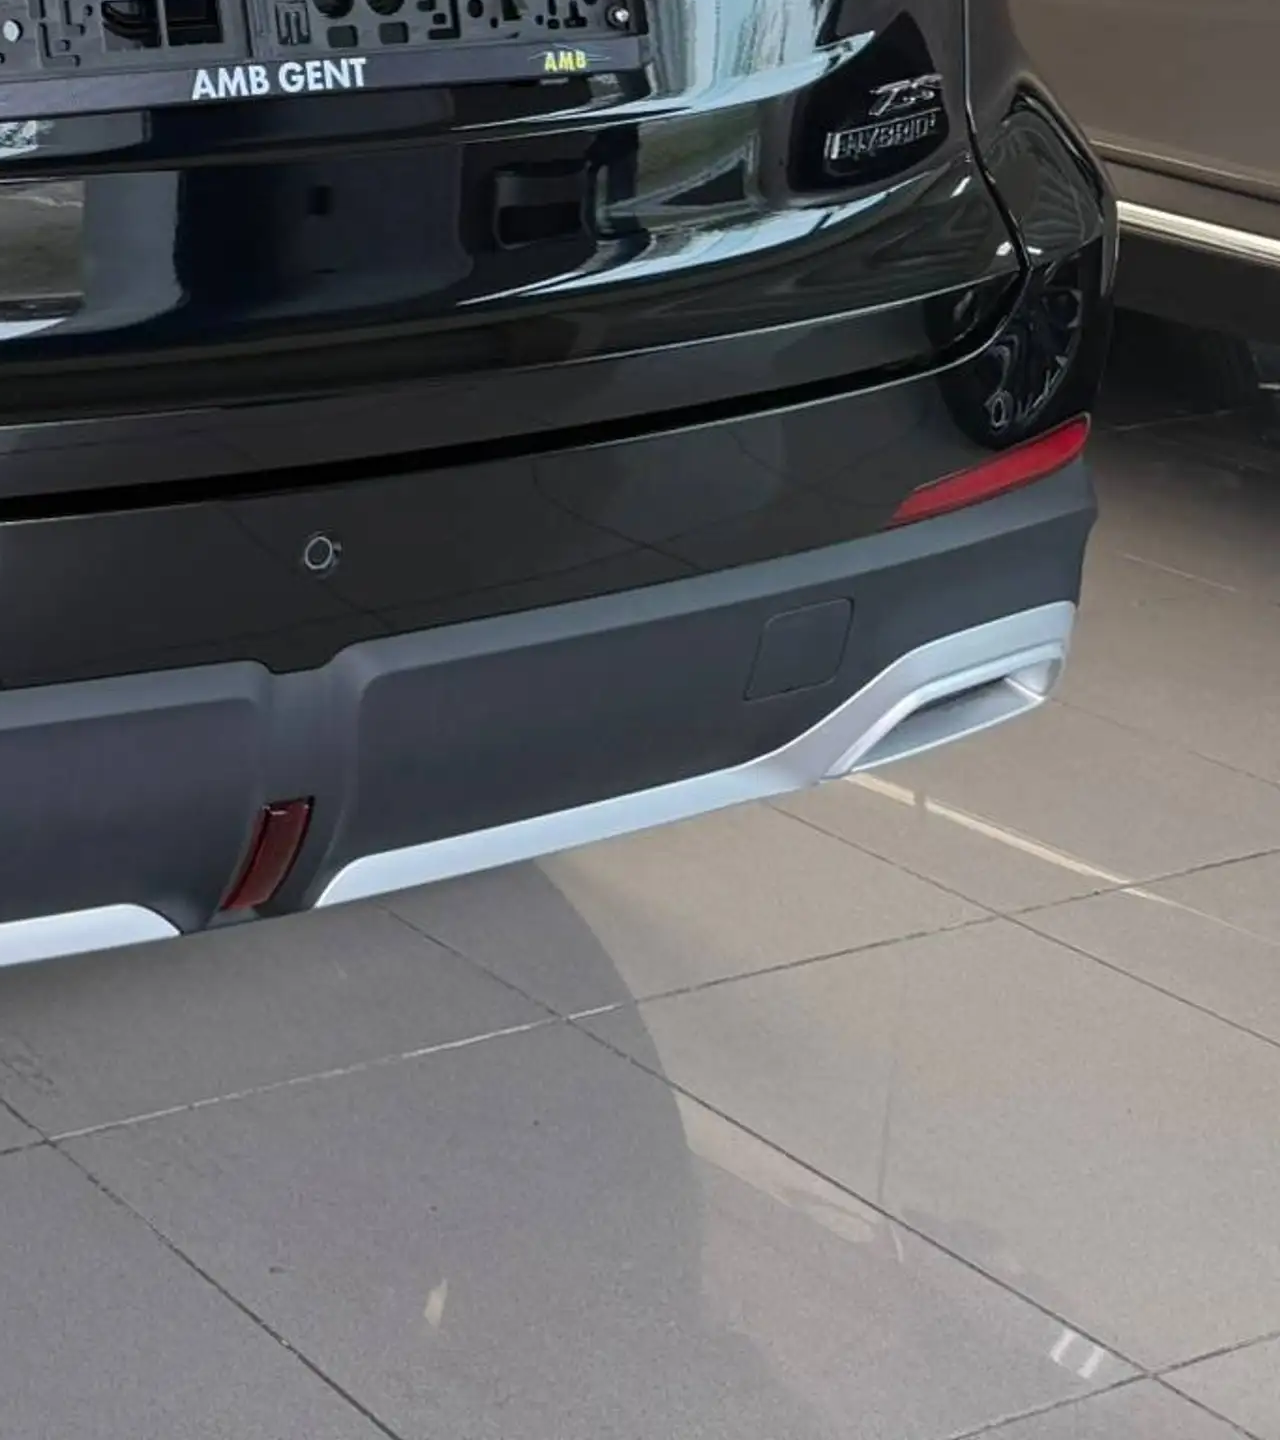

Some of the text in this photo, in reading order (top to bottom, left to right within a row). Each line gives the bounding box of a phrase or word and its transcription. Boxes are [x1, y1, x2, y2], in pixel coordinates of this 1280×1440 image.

[544, 48, 587, 72] AMB
[192, 57, 367, 101] AMB GENT
